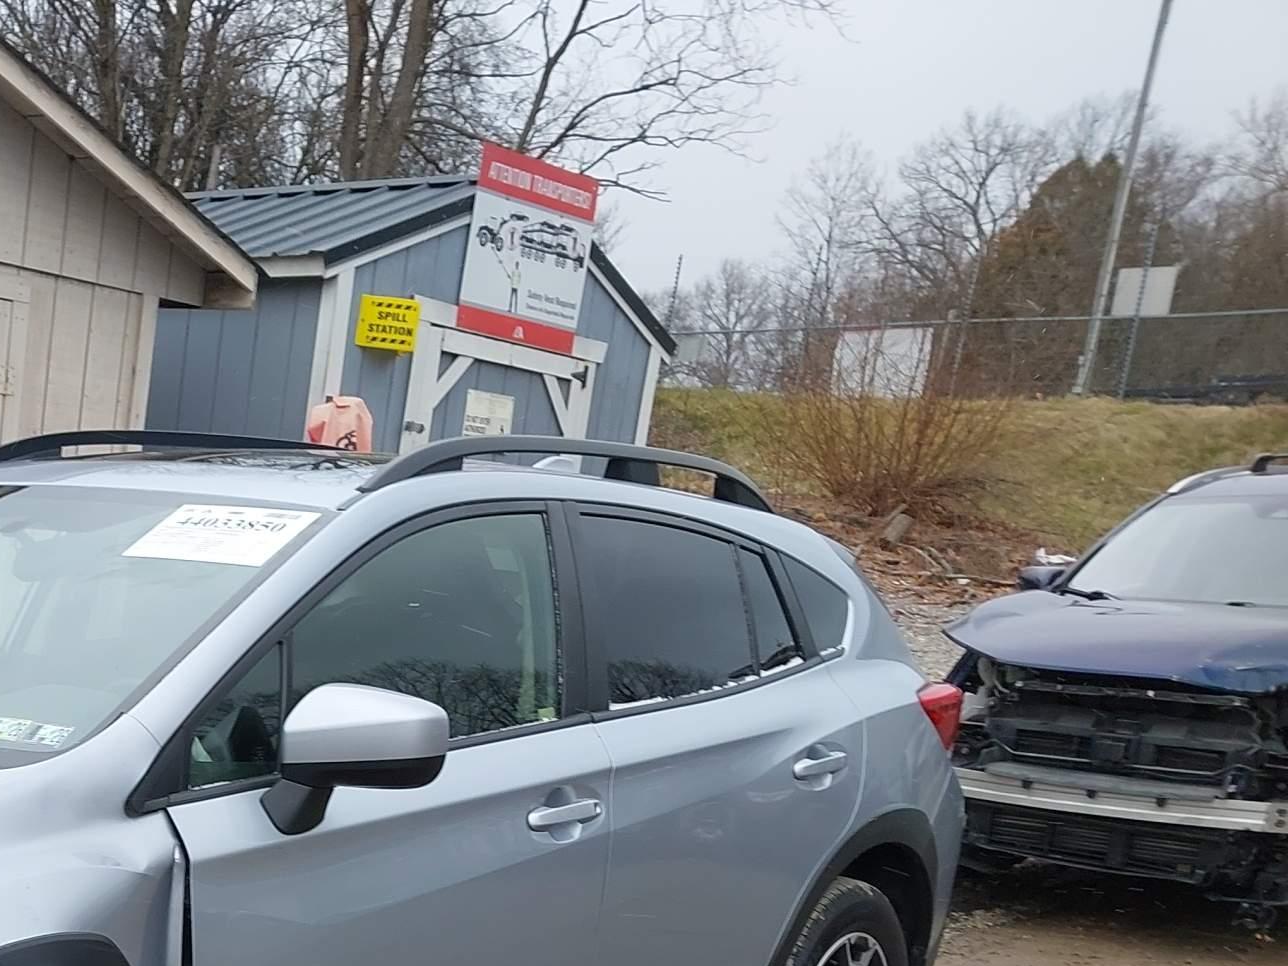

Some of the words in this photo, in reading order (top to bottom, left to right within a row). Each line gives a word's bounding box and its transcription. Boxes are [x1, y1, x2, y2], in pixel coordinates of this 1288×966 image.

[376, 310, 409, 323] SPILL
[367, 322, 414, 336] STATION
[176, 516, 288, 532] 44033850
